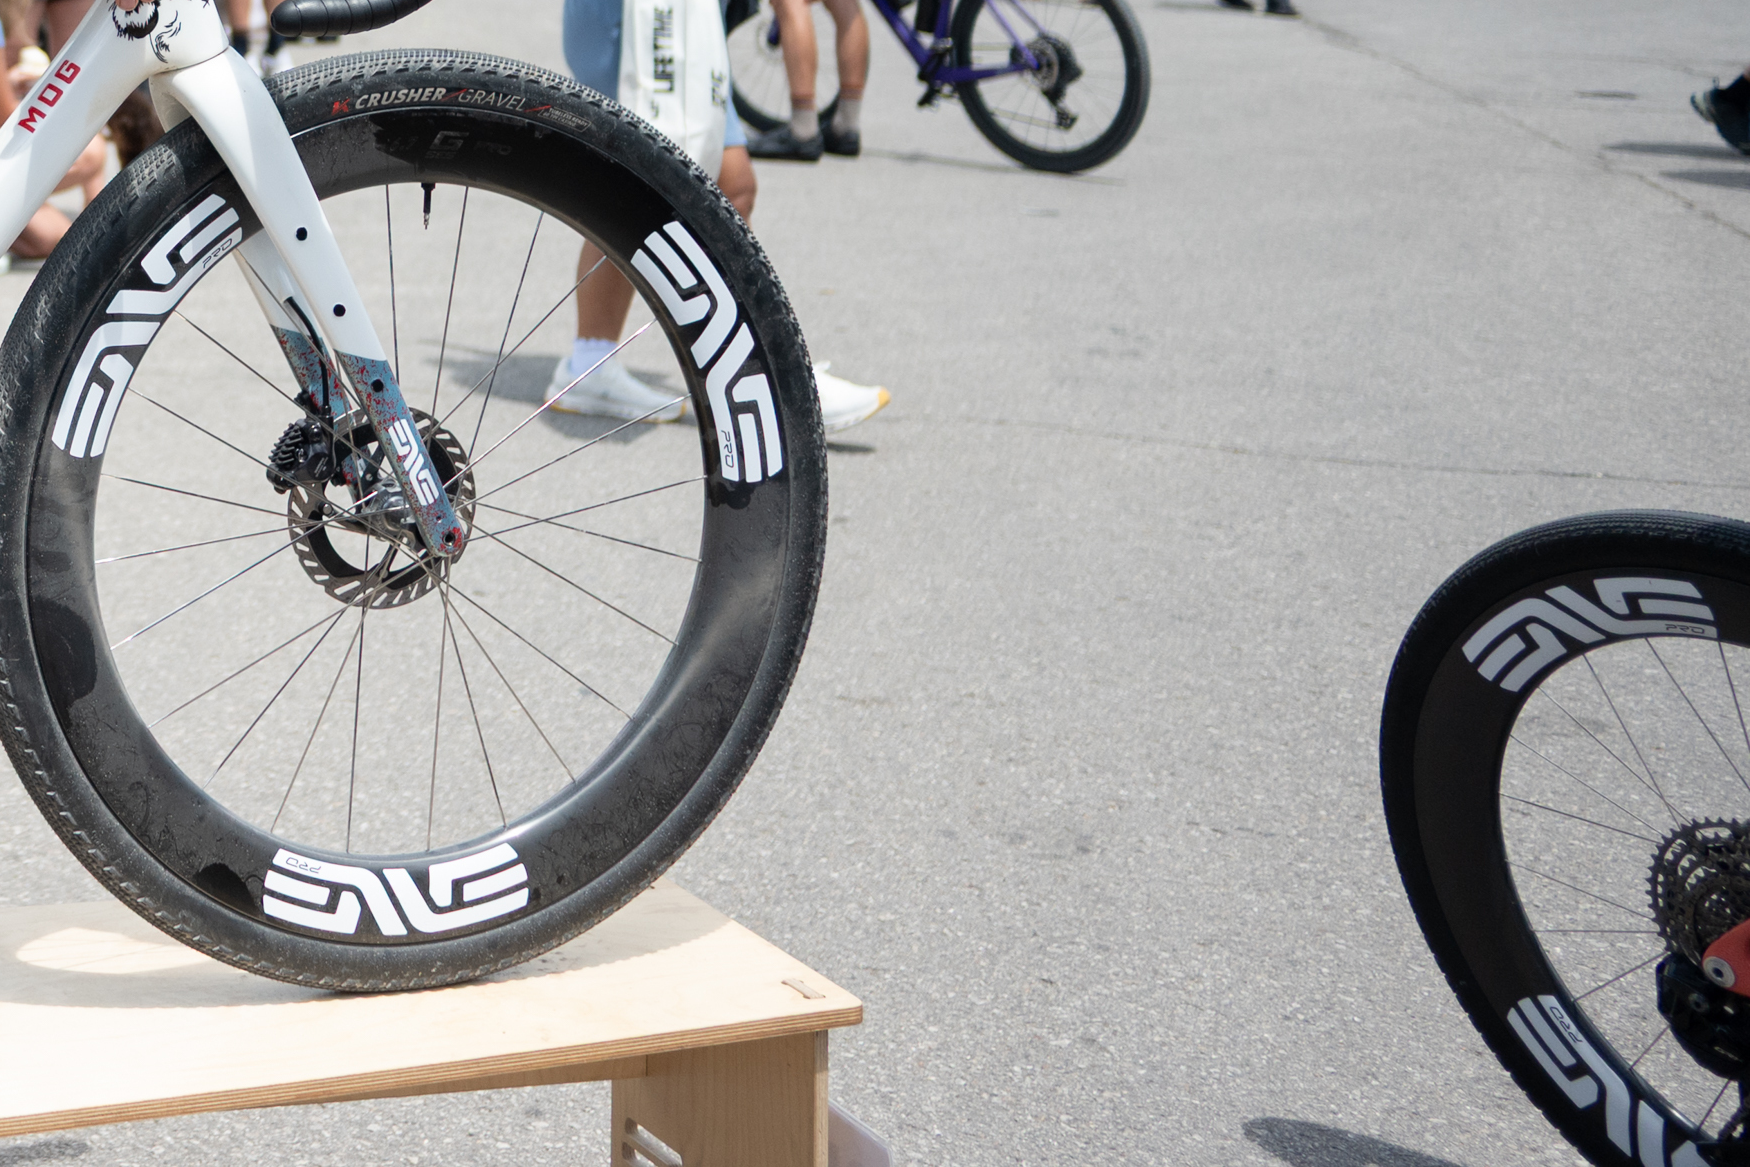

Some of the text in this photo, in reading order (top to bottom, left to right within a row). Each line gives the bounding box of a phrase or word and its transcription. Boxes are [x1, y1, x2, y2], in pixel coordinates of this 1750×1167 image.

[18, 59, 81, 134] MOG
[355, 87, 447, 110] CRUSHER
[457, 89, 526, 113] GRAVEL
[201, 237, 235, 269] PRO
[388, 419, 440, 506] ENVE
[720, 429, 736, 469] PRO
[1664, 623, 1705, 635] PRO
[285, 857, 321, 874] PRO
[1549, 1006, 1583, 1044] PRO
